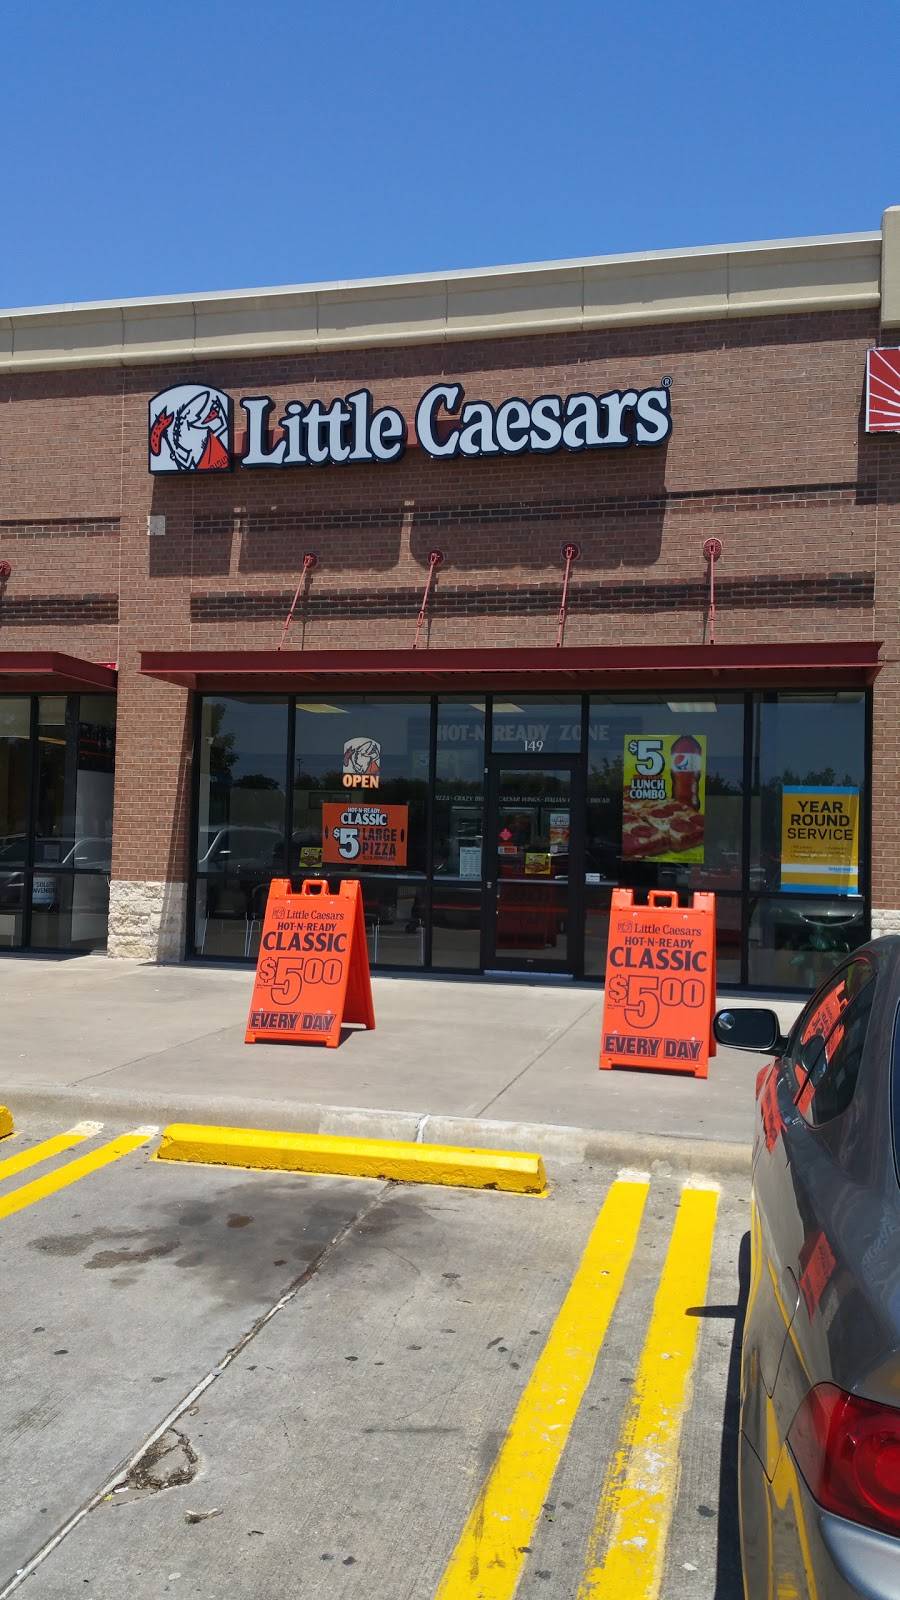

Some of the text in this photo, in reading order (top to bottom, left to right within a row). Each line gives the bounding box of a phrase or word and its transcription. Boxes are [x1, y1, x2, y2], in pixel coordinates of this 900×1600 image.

[241, 389, 406, 467] Little
[417, 383, 671, 458] Caesars
[524, 740, 544, 752] 149
[628, 739, 666, 777] $5
[343, 774, 379, 788] OPEN
[631, 779, 665, 790] LUNCH
[629, 789, 667, 800] COMBO
[798, 800, 843, 813] YEAR
[340, 812, 387, 826] CLASSIC
[790, 813, 850, 826] ROUND
[362, 828, 397, 842] LARGE
[787, 827, 853, 840] SERVICE
[333, 828, 360, 859] $5
[362, 842, 397, 856] PIZZA
[286, 909, 345, 920] Little Caesars
[277, 922, 337, 931] HOT-N-READY
[634, 922, 702, 936] Little Caesars
[262, 931, 347, 952] CLASSIC
[624, 936, 695, 949] HOT-N-READY
[609, 946, 707, 972] CLASSIC
[250, 1011, 336, 1031] EVERY DAY
[604, 1034, 702, 1060] EVERY DAY
